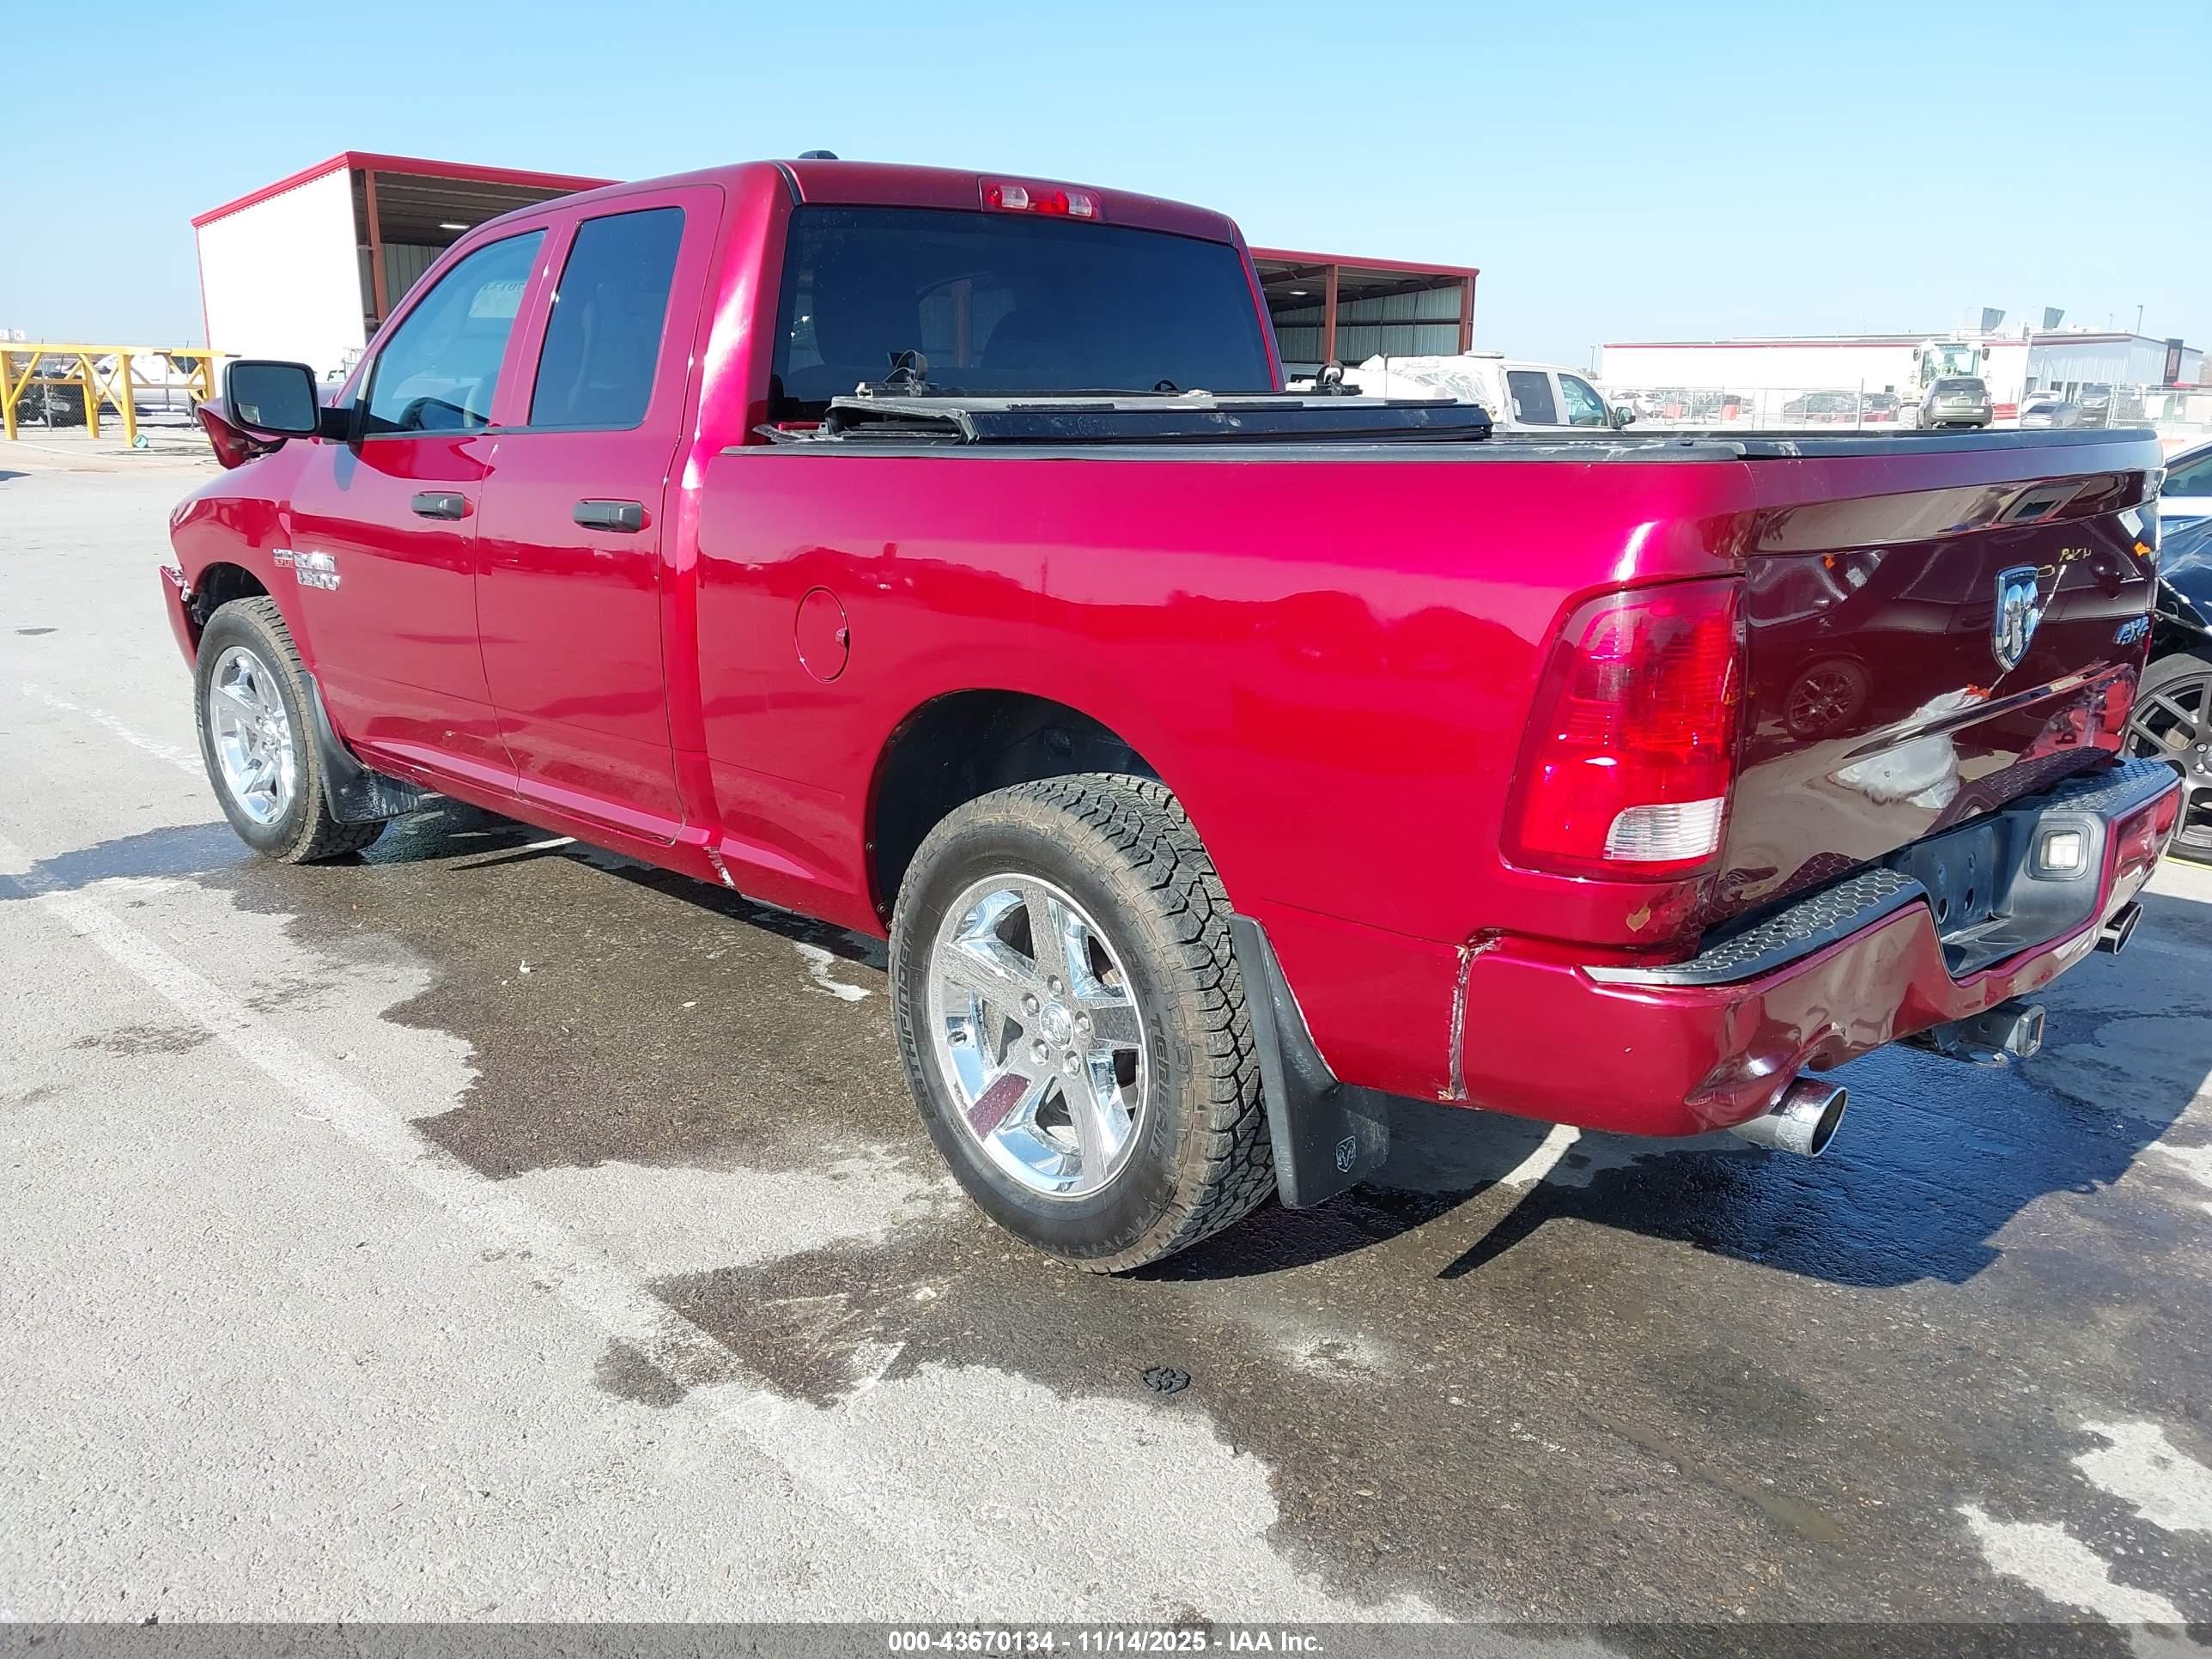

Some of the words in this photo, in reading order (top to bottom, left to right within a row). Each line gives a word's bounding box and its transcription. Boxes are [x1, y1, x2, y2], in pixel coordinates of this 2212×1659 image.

[295, 568, 342, 591] 1500
[898, 926, 937, 1118] PATHFINDER
[1147, 1012, 1171, 1158] TERRAIN
